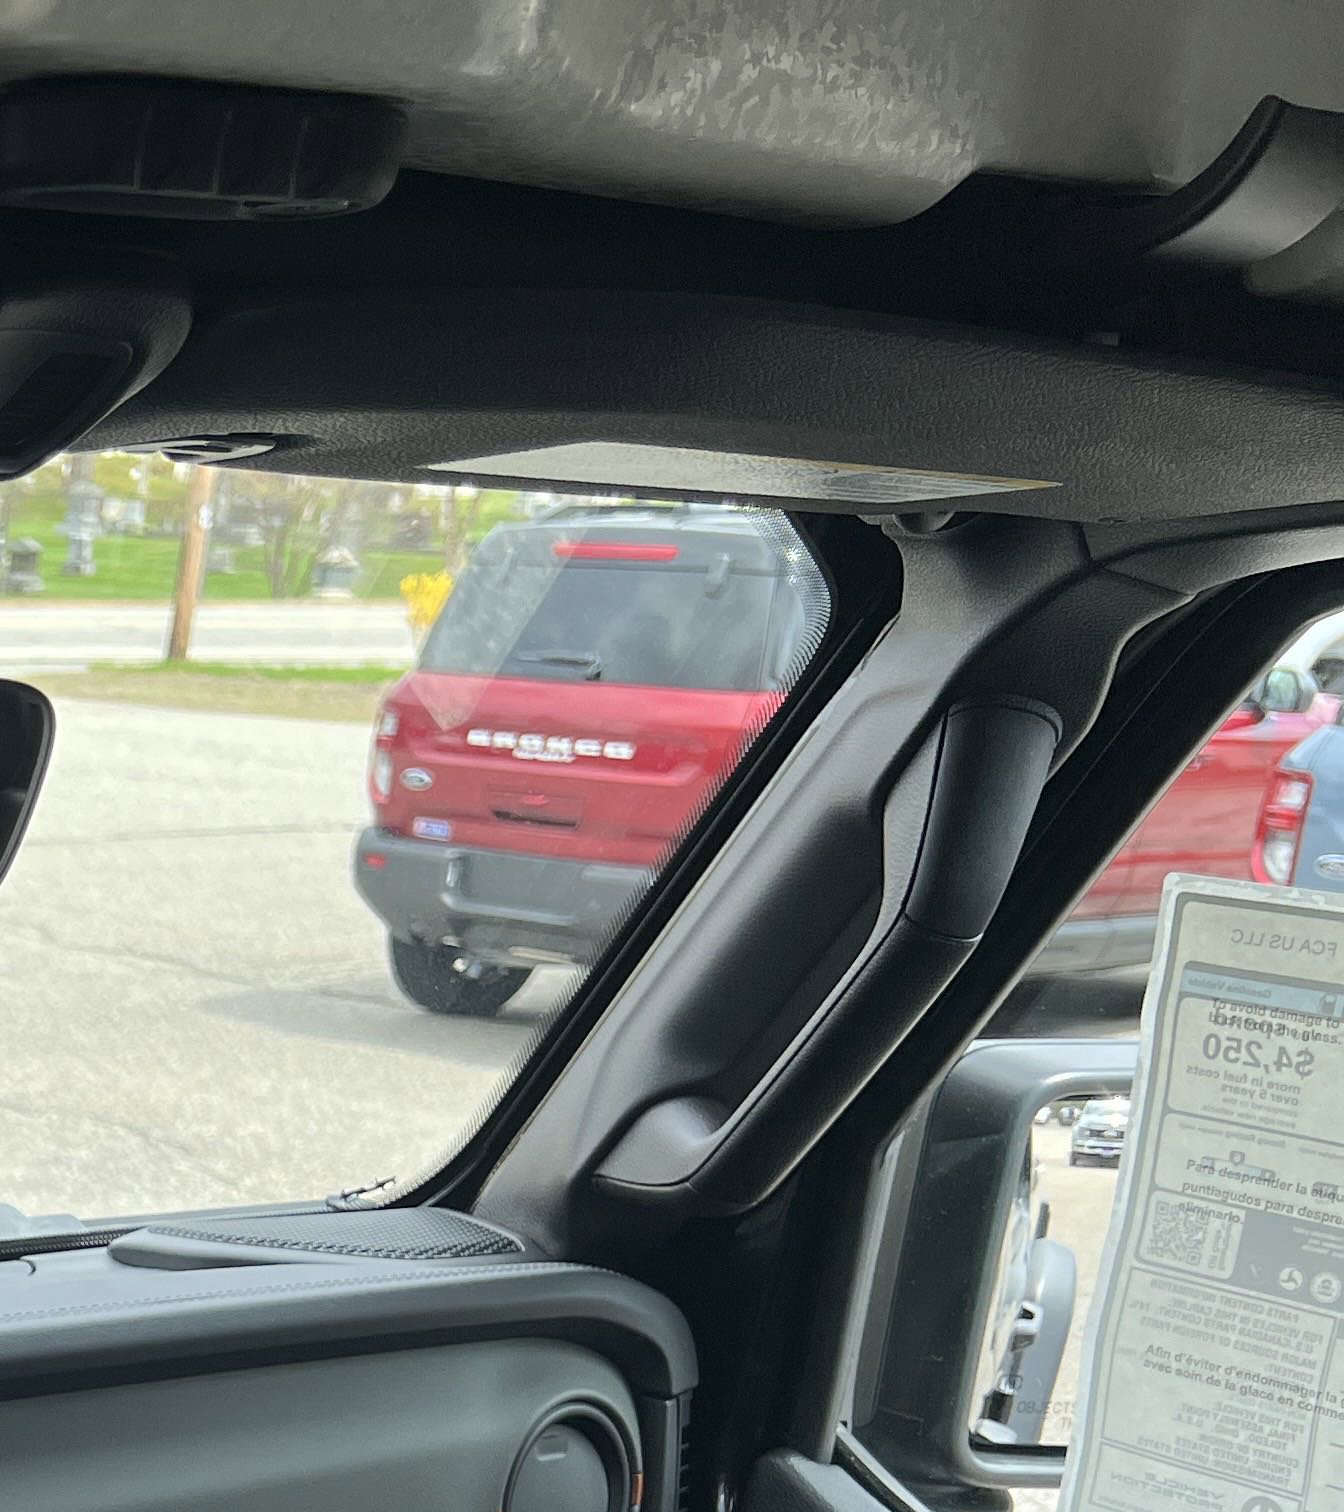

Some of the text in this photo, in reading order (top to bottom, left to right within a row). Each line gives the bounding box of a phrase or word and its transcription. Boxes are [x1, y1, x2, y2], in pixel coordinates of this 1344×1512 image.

[467, 728, 637, 761] BRONCO
[1270, 1007, 1322, 1028] damage
[1182, 1182, 1294, 1214] puntiagudos para
[1144, 1343, 1171, 1360] Afin
[1143, 1358, 1294, 1407] avec soin de en
